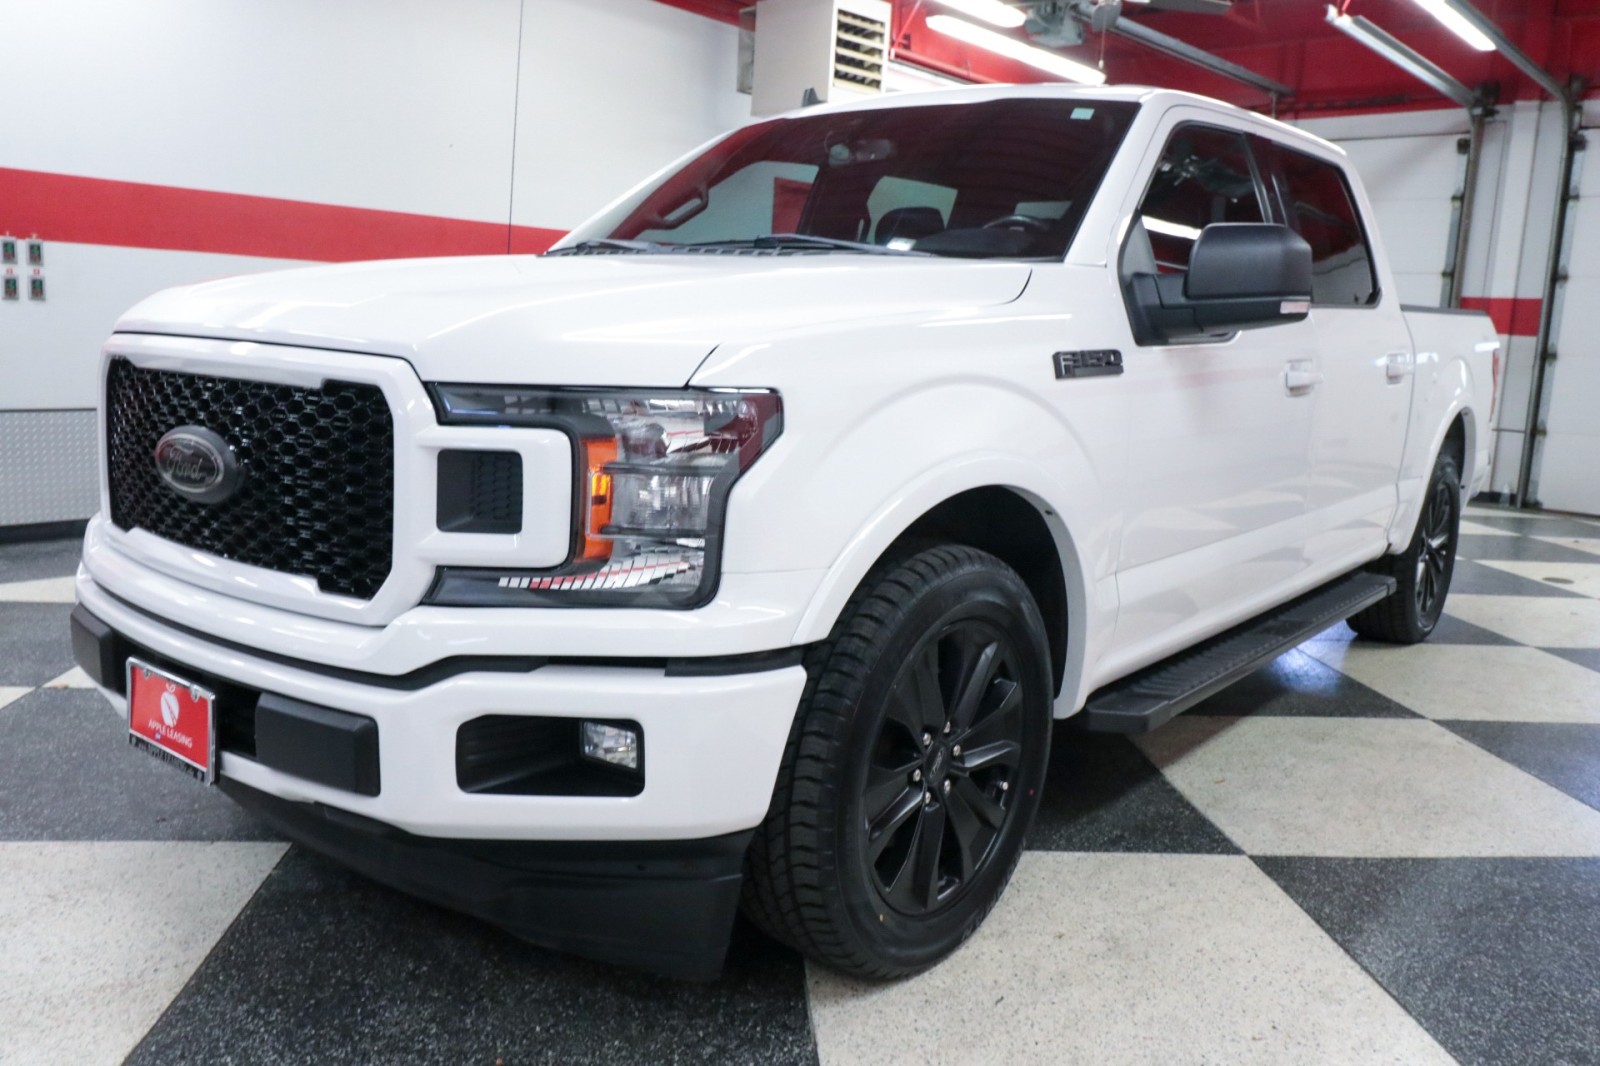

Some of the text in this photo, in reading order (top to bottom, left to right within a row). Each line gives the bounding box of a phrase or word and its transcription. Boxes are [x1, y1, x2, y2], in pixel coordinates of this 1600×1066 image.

[166, 442, 208, 480] Ford
[148, 718, 193, 749] APPLE LEASING
